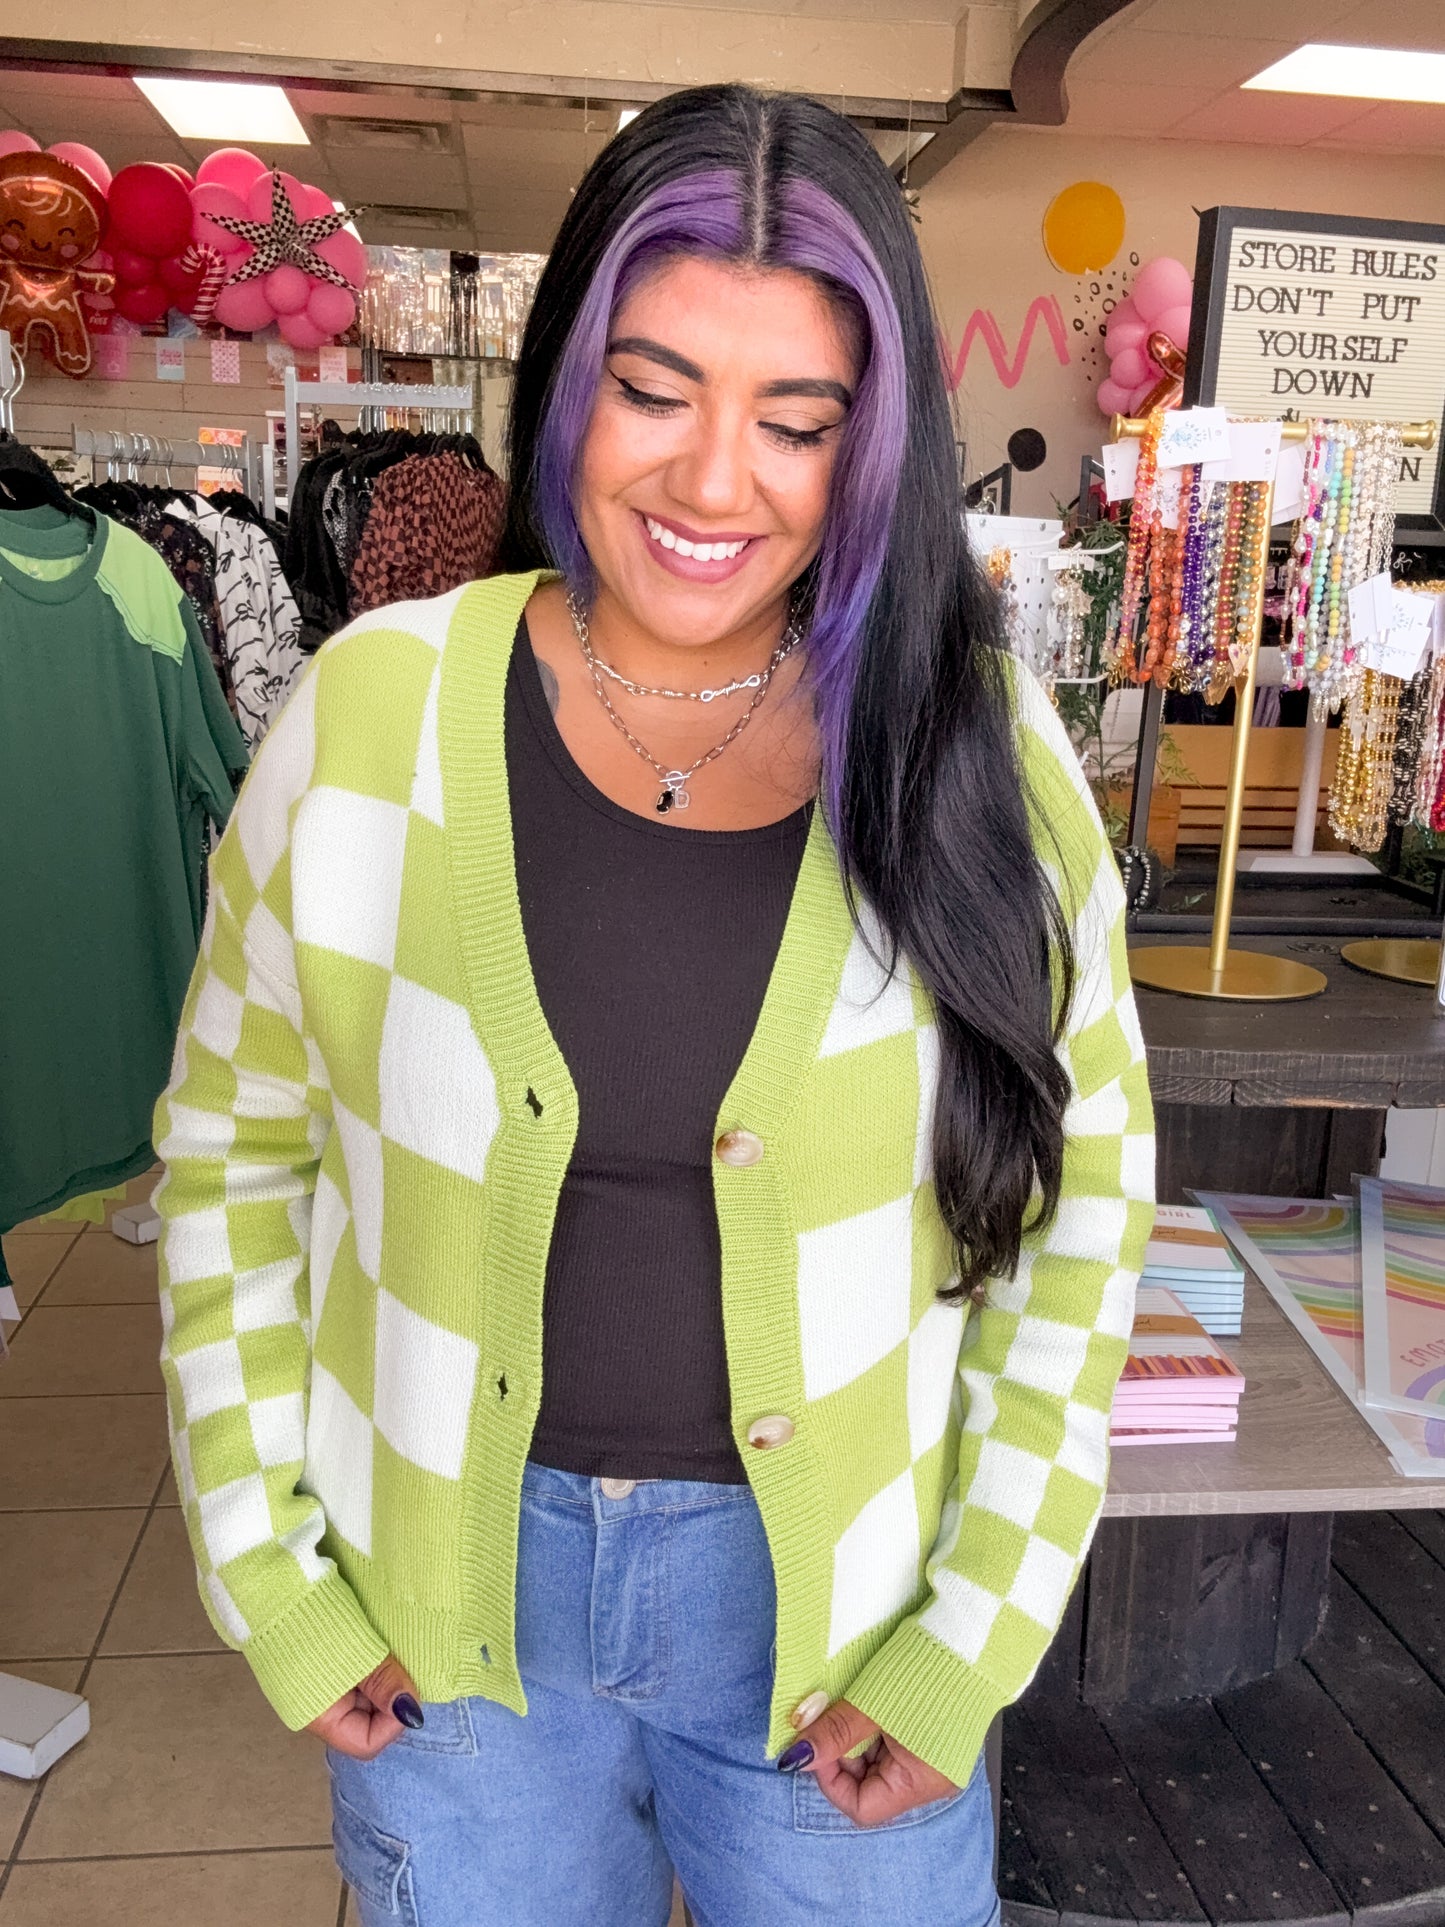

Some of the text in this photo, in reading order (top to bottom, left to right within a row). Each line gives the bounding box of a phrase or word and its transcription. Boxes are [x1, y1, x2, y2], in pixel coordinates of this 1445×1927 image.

[1238, 240, 1438, 281] STORE RULES
[1231, 284, 1421, 323] DON'T PUT
[1257, 329, 1409, 363] YOURSELF
[1271, 367, 1375, 399] DOWN
